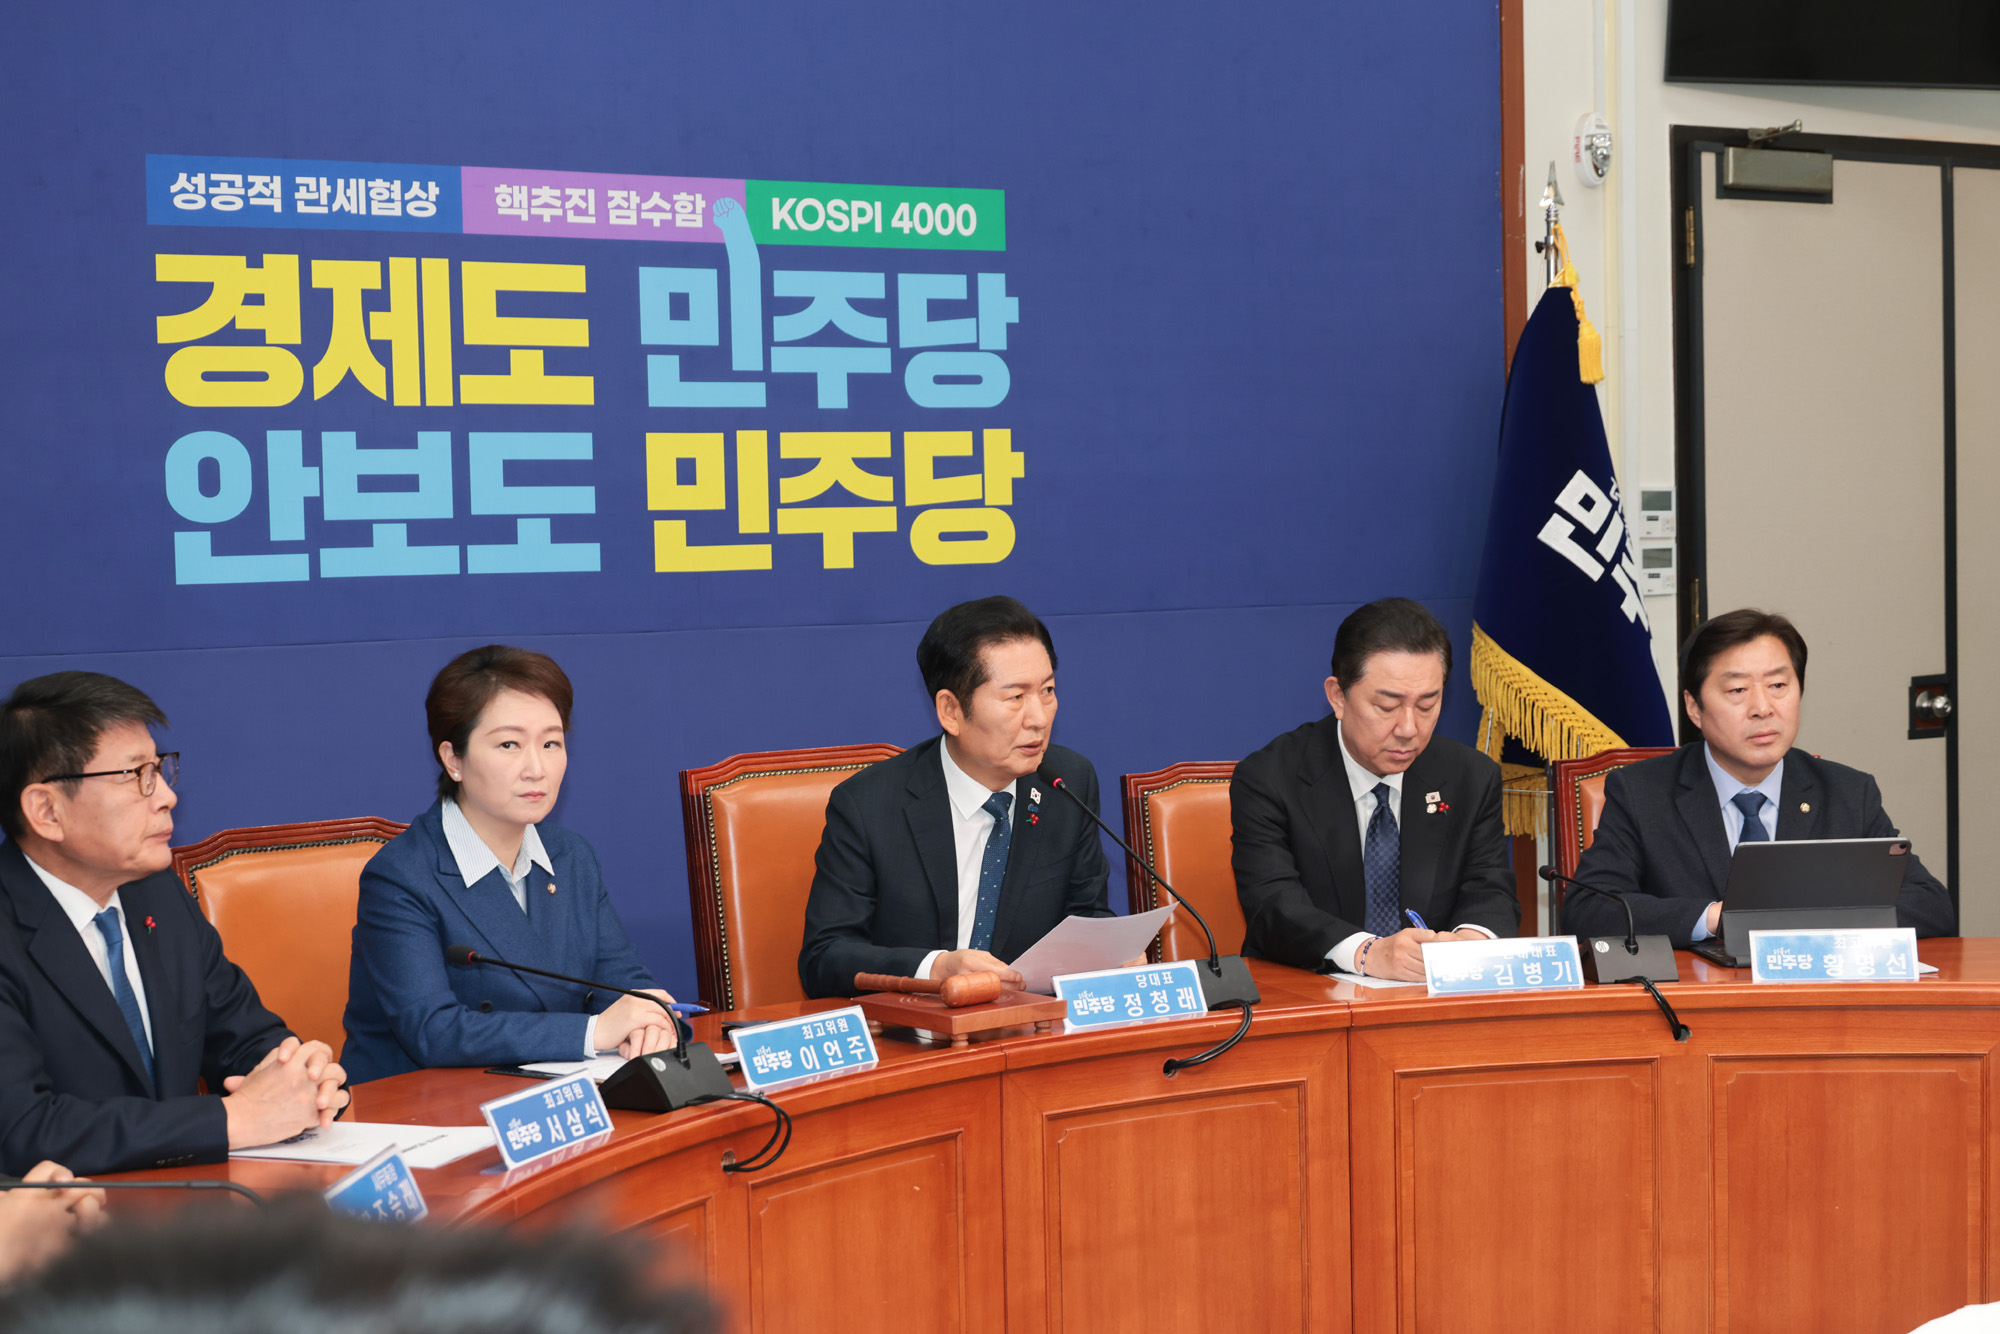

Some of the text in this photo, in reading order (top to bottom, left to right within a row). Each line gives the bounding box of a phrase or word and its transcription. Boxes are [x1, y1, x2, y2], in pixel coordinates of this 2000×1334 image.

[169, 172, 440, 218] 성공적 관세협상
[494, 184, 706, 229] 핵추진 잠수함
[771, 197, 978, 237] KOSPI 4000
[155, 253, 1020, 410] 경제도 민주당
[164, 428, 1026, 586] 안보도 민주당
[1135, 971, 1175, 988] 당대표
[1493, 959, 1573, 986] 김병기
[1766, 954, 1813, 970] 민주당
[1072, 986, 1198, 1017] 민주당 정청래
[801, 1017, 850, 1040] 최고위원
[752, 1035, 866, 1074] 민주당 이언주
[506, 1100, 605, 1151] 민주당 서삼석
